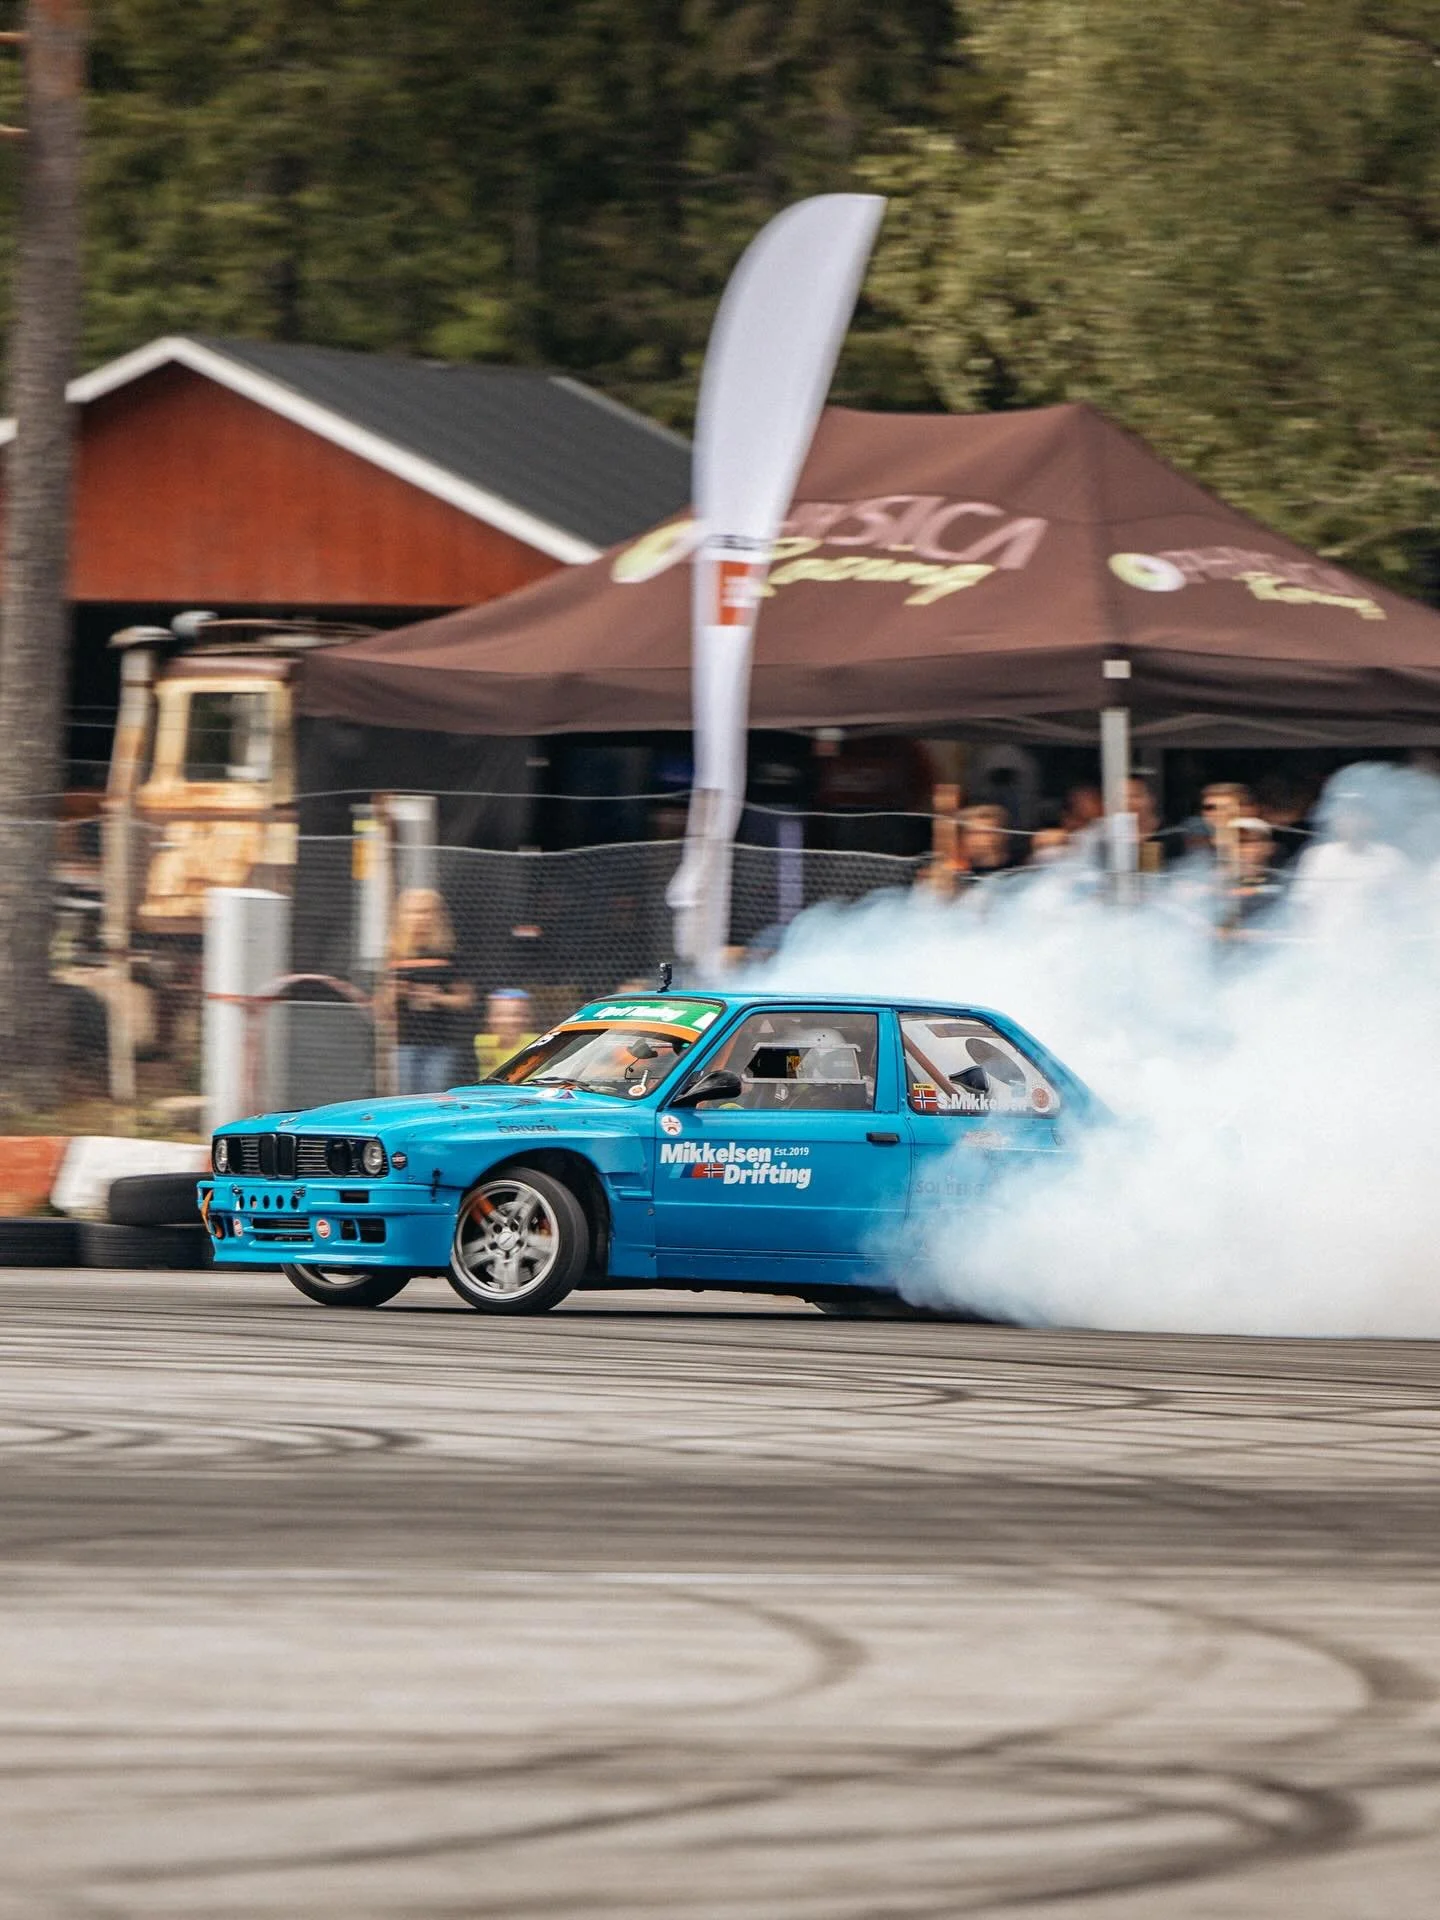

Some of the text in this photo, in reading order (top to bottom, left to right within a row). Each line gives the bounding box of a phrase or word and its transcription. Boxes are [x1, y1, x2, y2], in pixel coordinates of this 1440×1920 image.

[497, 1125, 558, 1134] DRIVEN
[660, 1142, 810, 1164] Mikkelsen Est.2019
[723, 1162, 811, 1189] Drifting
